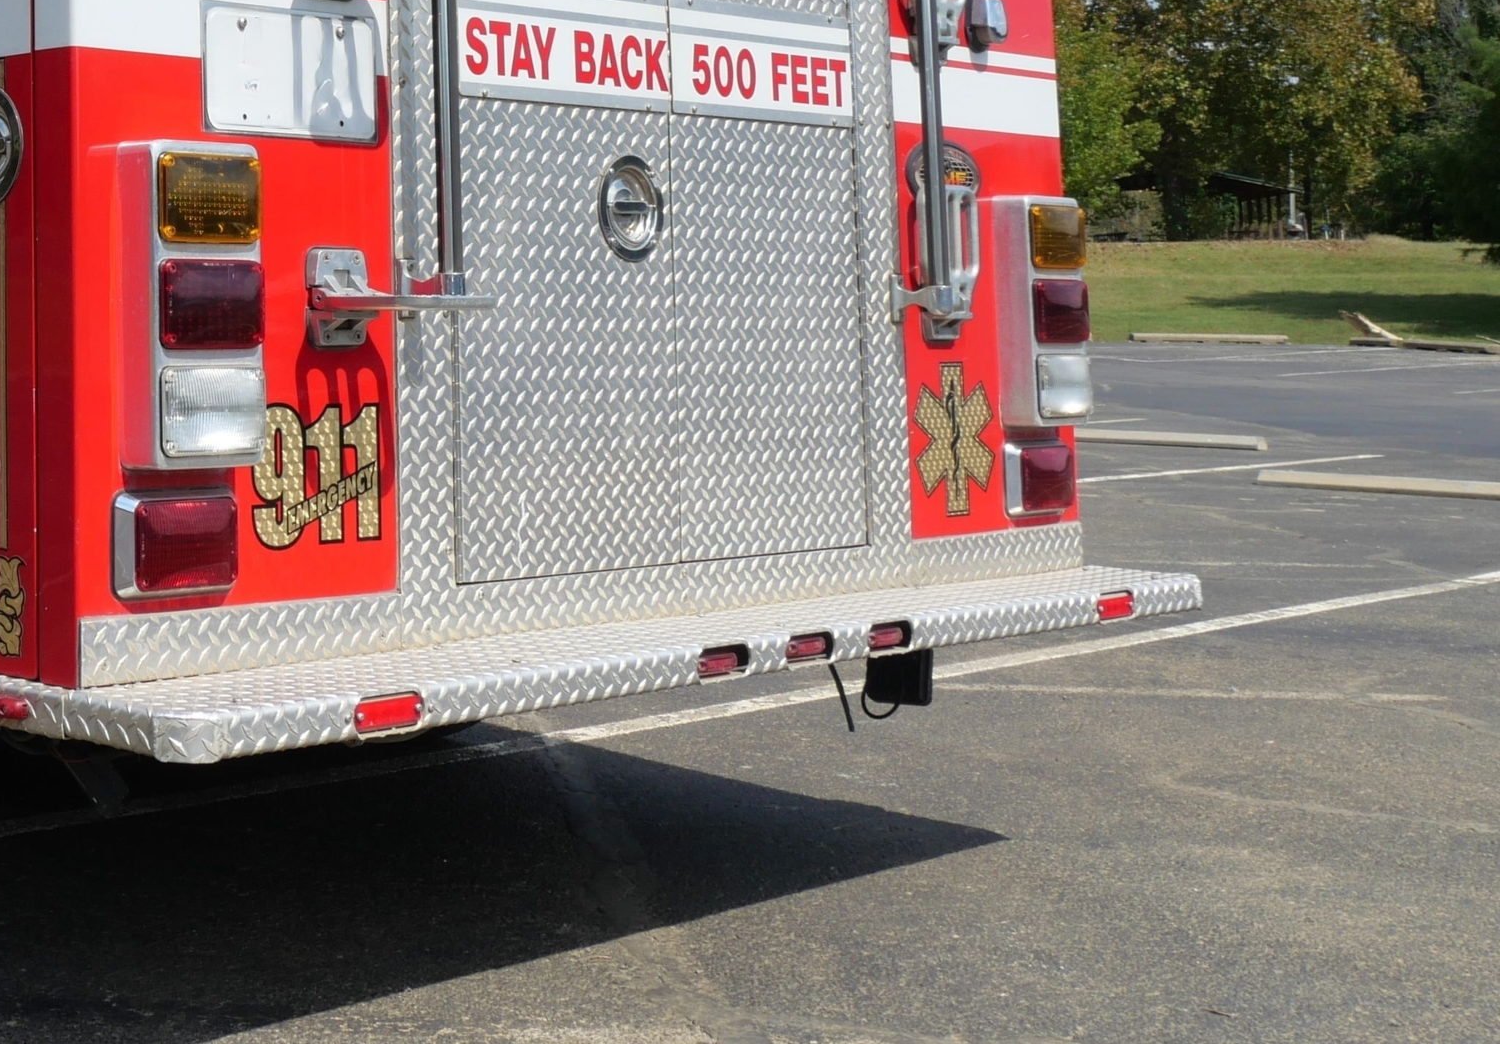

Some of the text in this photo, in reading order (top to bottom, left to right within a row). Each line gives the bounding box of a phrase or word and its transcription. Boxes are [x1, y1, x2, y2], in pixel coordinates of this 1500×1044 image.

[465, 16, 847, 107] STAY BACK 500 FEET
[251, 402, 382, 551] 911
[286, 461, 376, 535] EMERGENCY
